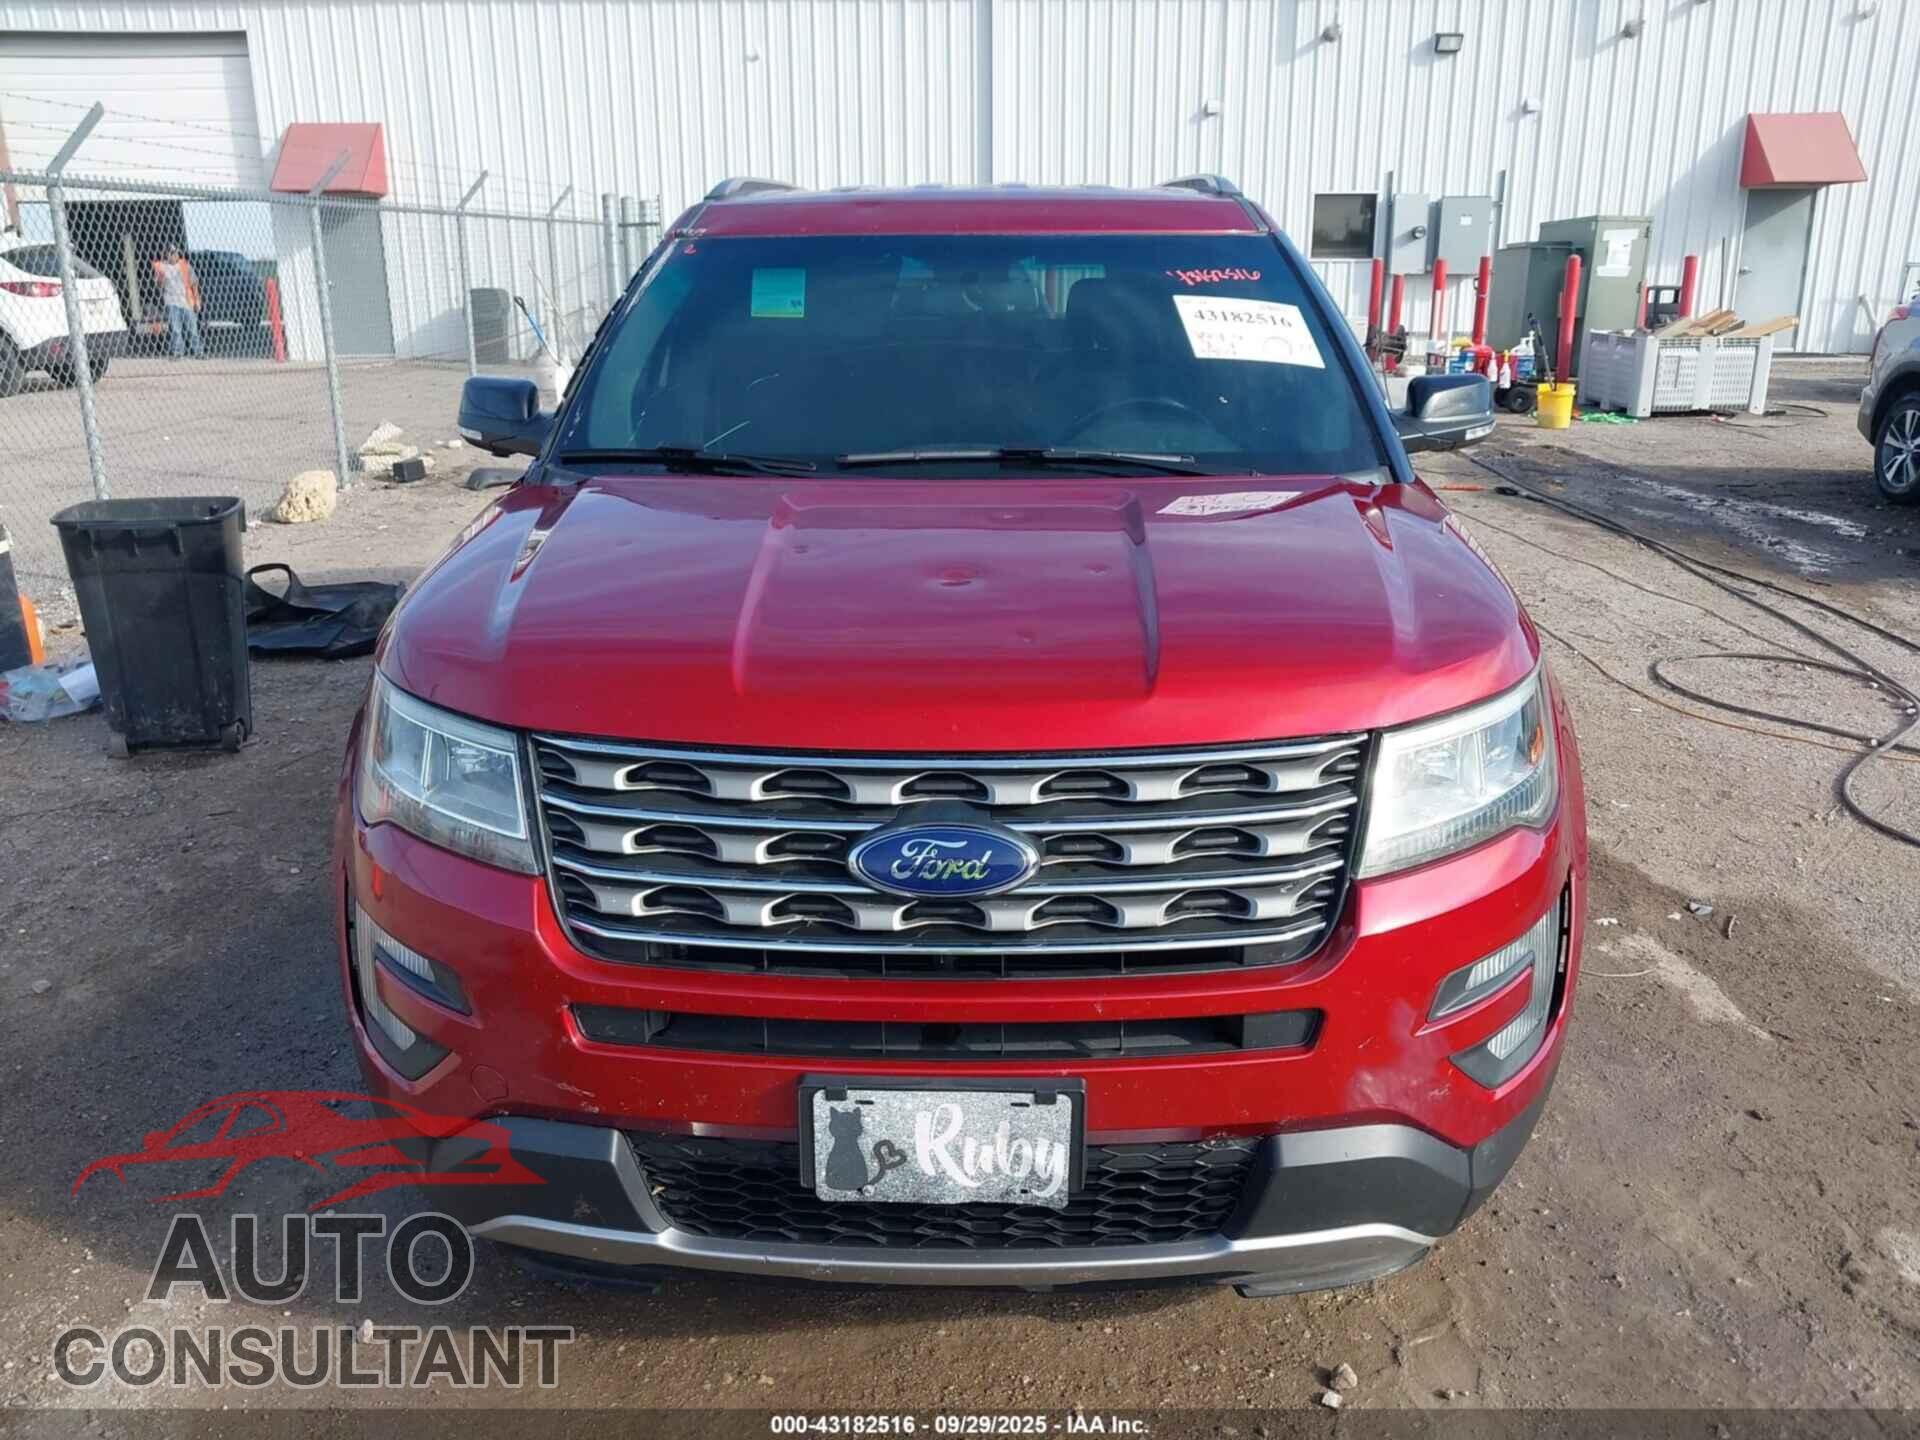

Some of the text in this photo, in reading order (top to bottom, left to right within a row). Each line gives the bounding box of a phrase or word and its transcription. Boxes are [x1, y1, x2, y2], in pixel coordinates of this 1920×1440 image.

[1194, 308, 1293, 328] 43182516
[890, 837, 993, 881] Ford
[915, 1103, 1066, 1198] Ruby
